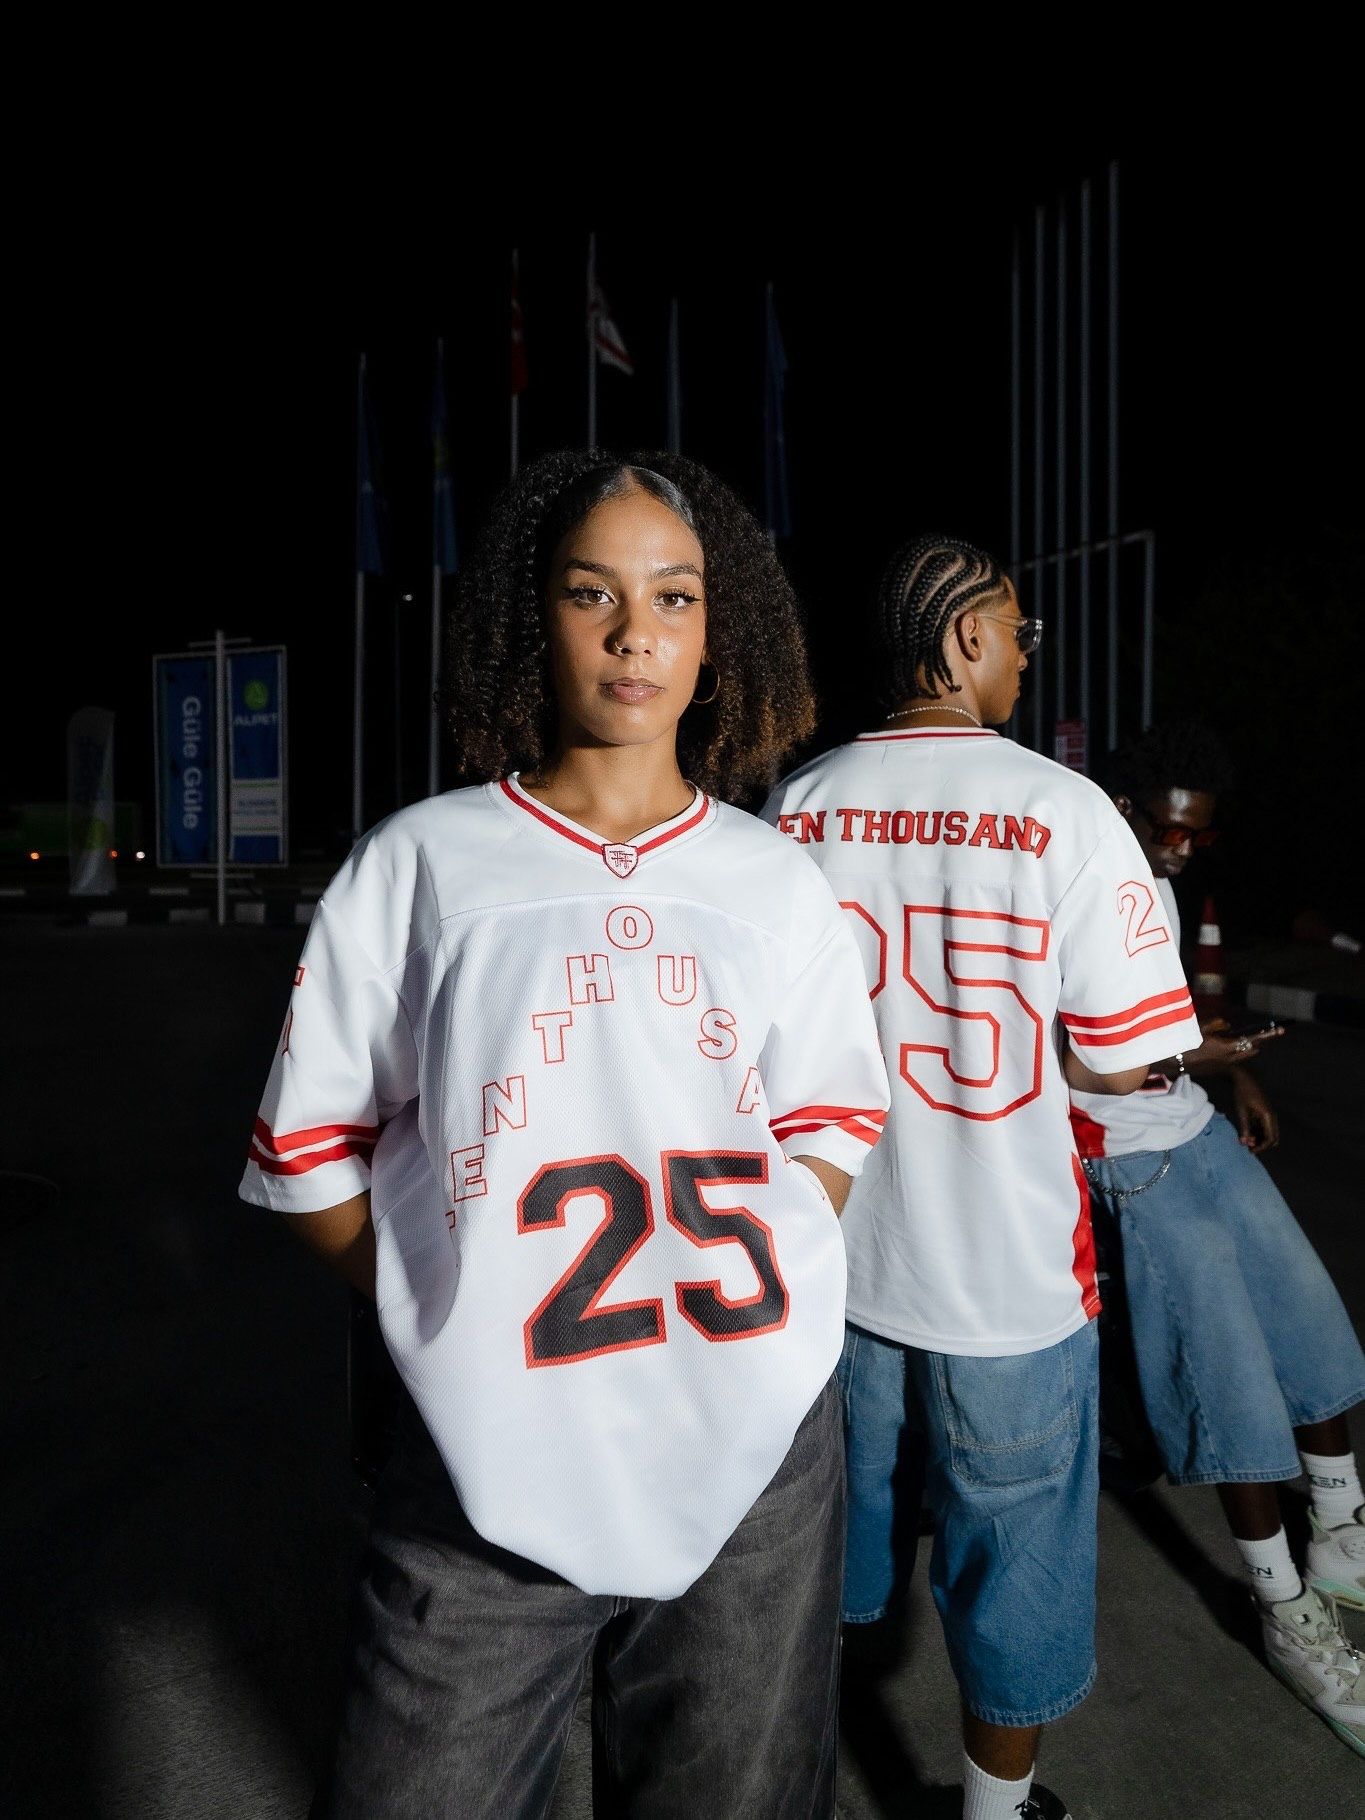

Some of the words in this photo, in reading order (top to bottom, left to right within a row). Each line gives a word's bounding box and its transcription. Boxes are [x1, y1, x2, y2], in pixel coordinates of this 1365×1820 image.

[836, 808, 1052, 859] THOUSAND
[1117, 880, 1169, 958] 2
[838, 900, 1051, 1122] 5
[516, 1149, 791, 1370] 25
